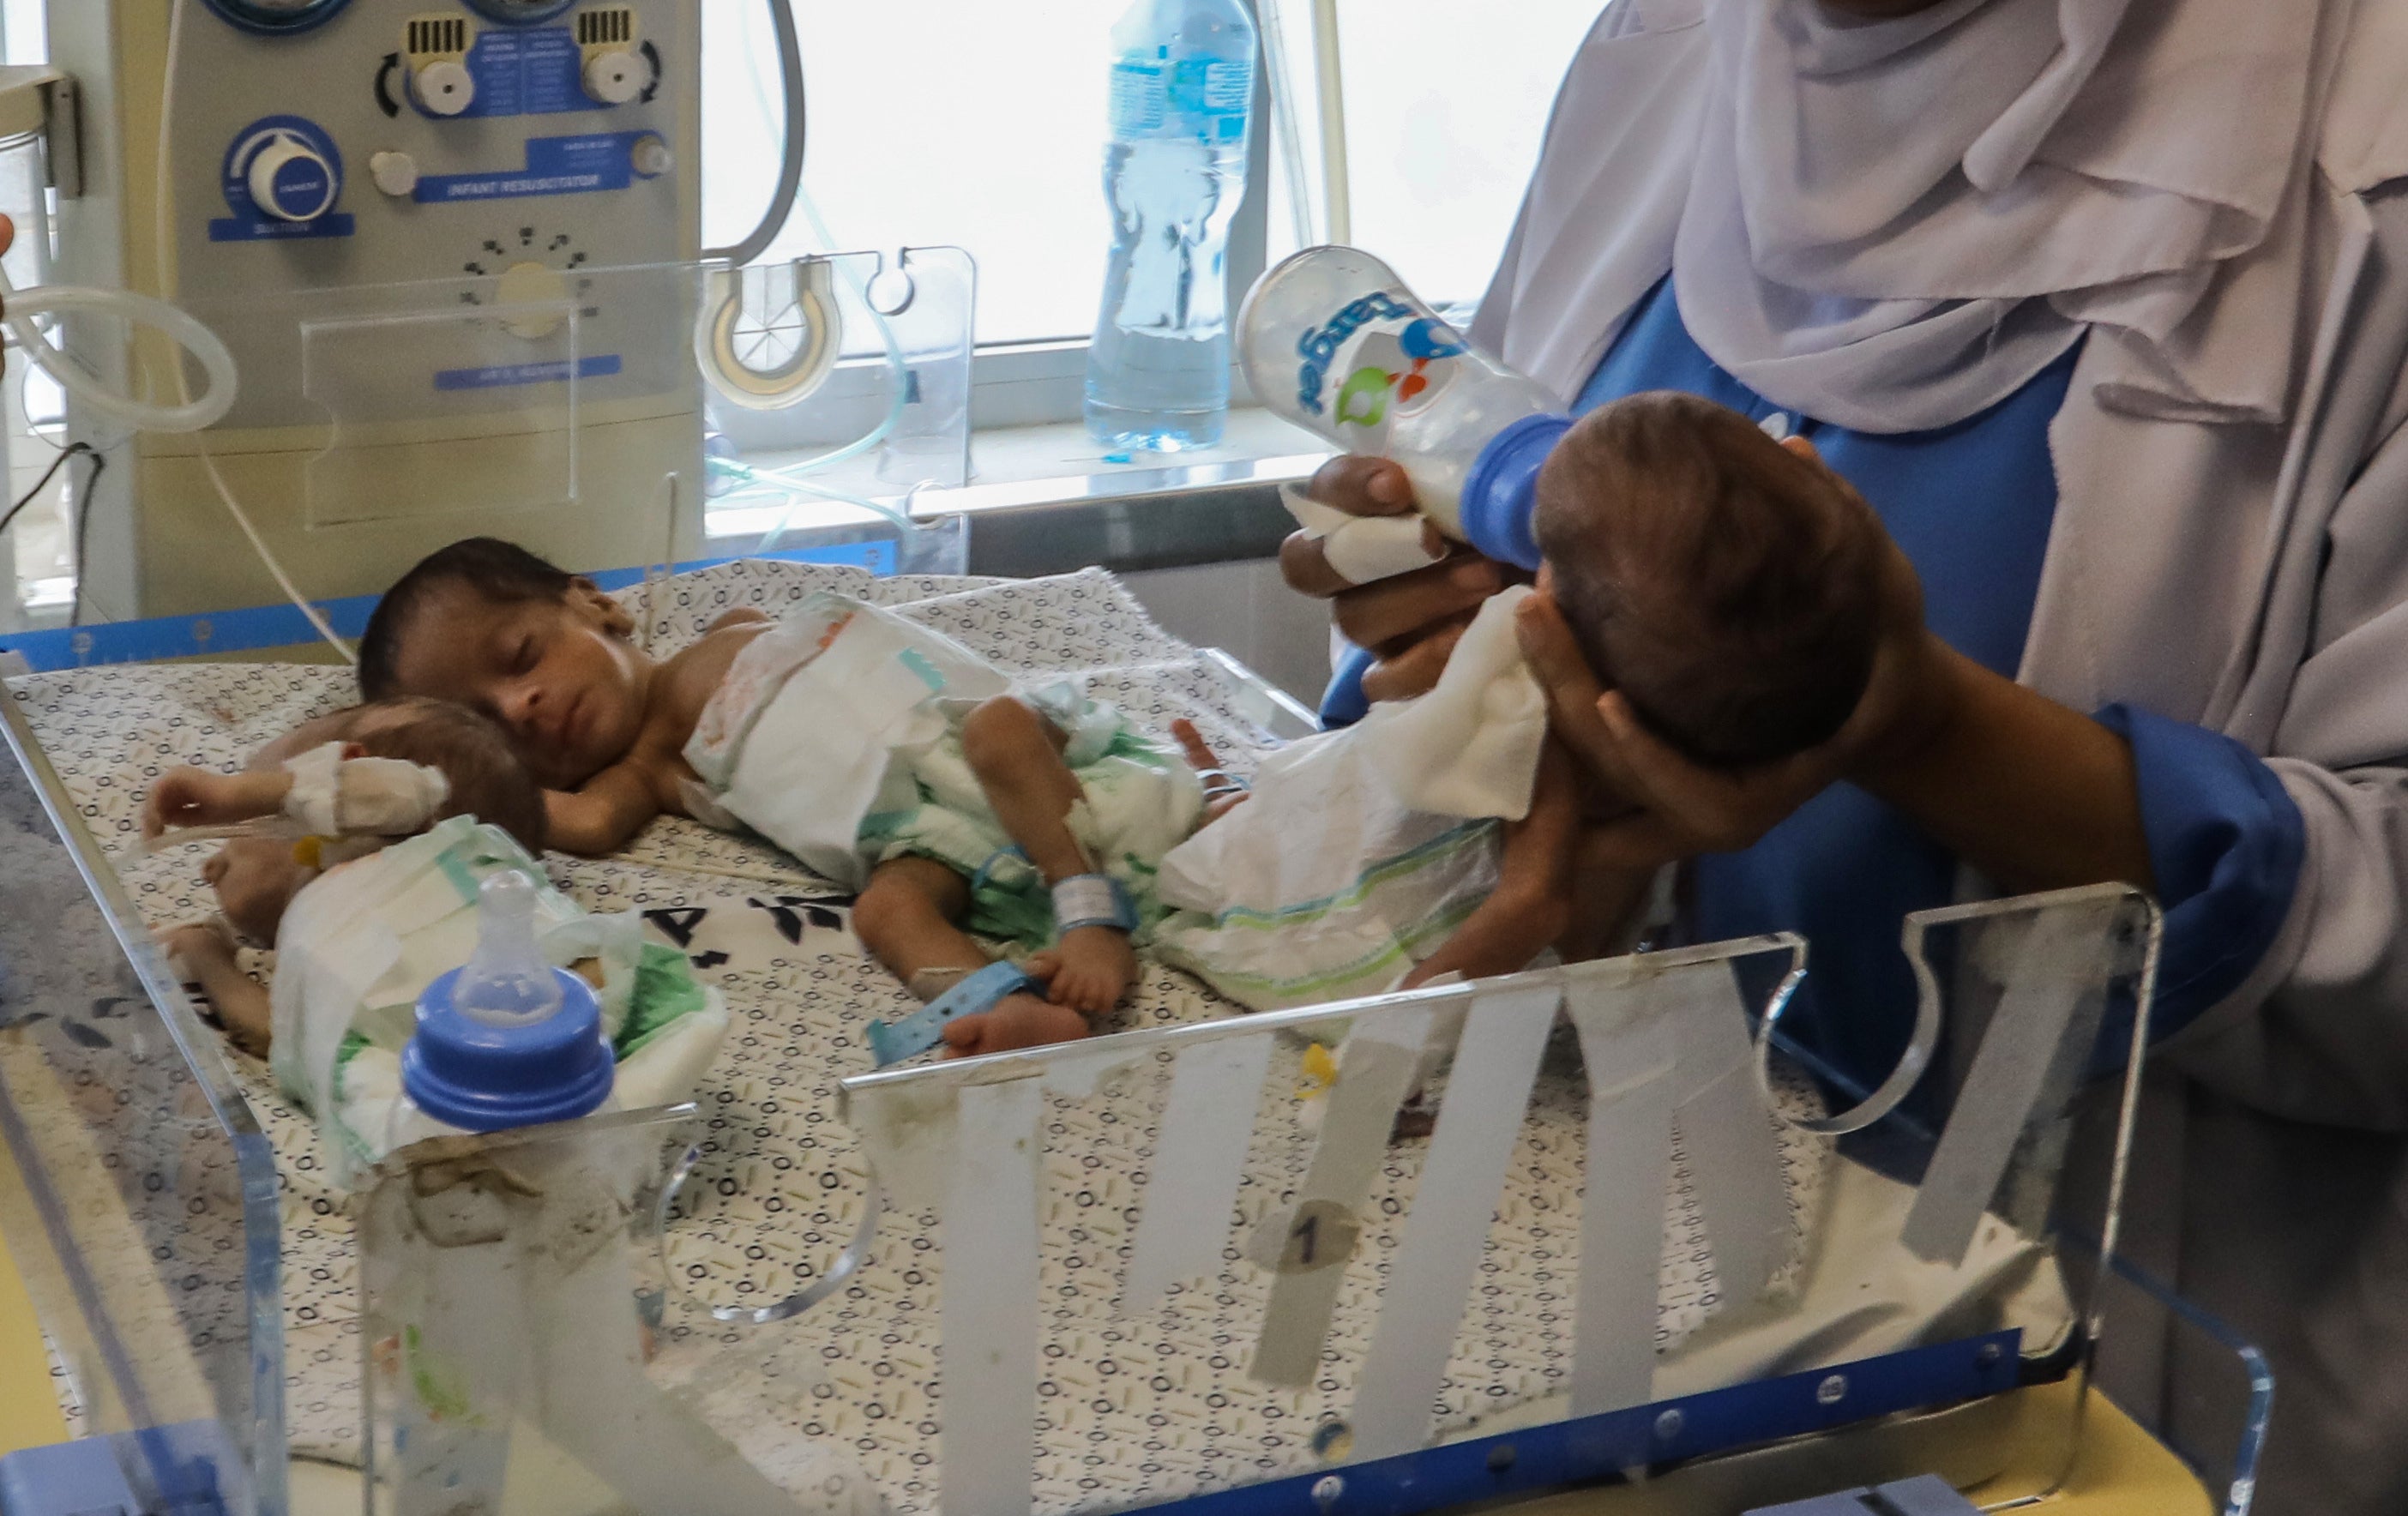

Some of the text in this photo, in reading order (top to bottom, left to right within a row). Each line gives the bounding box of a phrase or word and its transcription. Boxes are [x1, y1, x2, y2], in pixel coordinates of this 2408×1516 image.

[449, 175, 599, 196] INFANT RESUSCITATOR
[1292, 1215, 1319, 1264] 1
